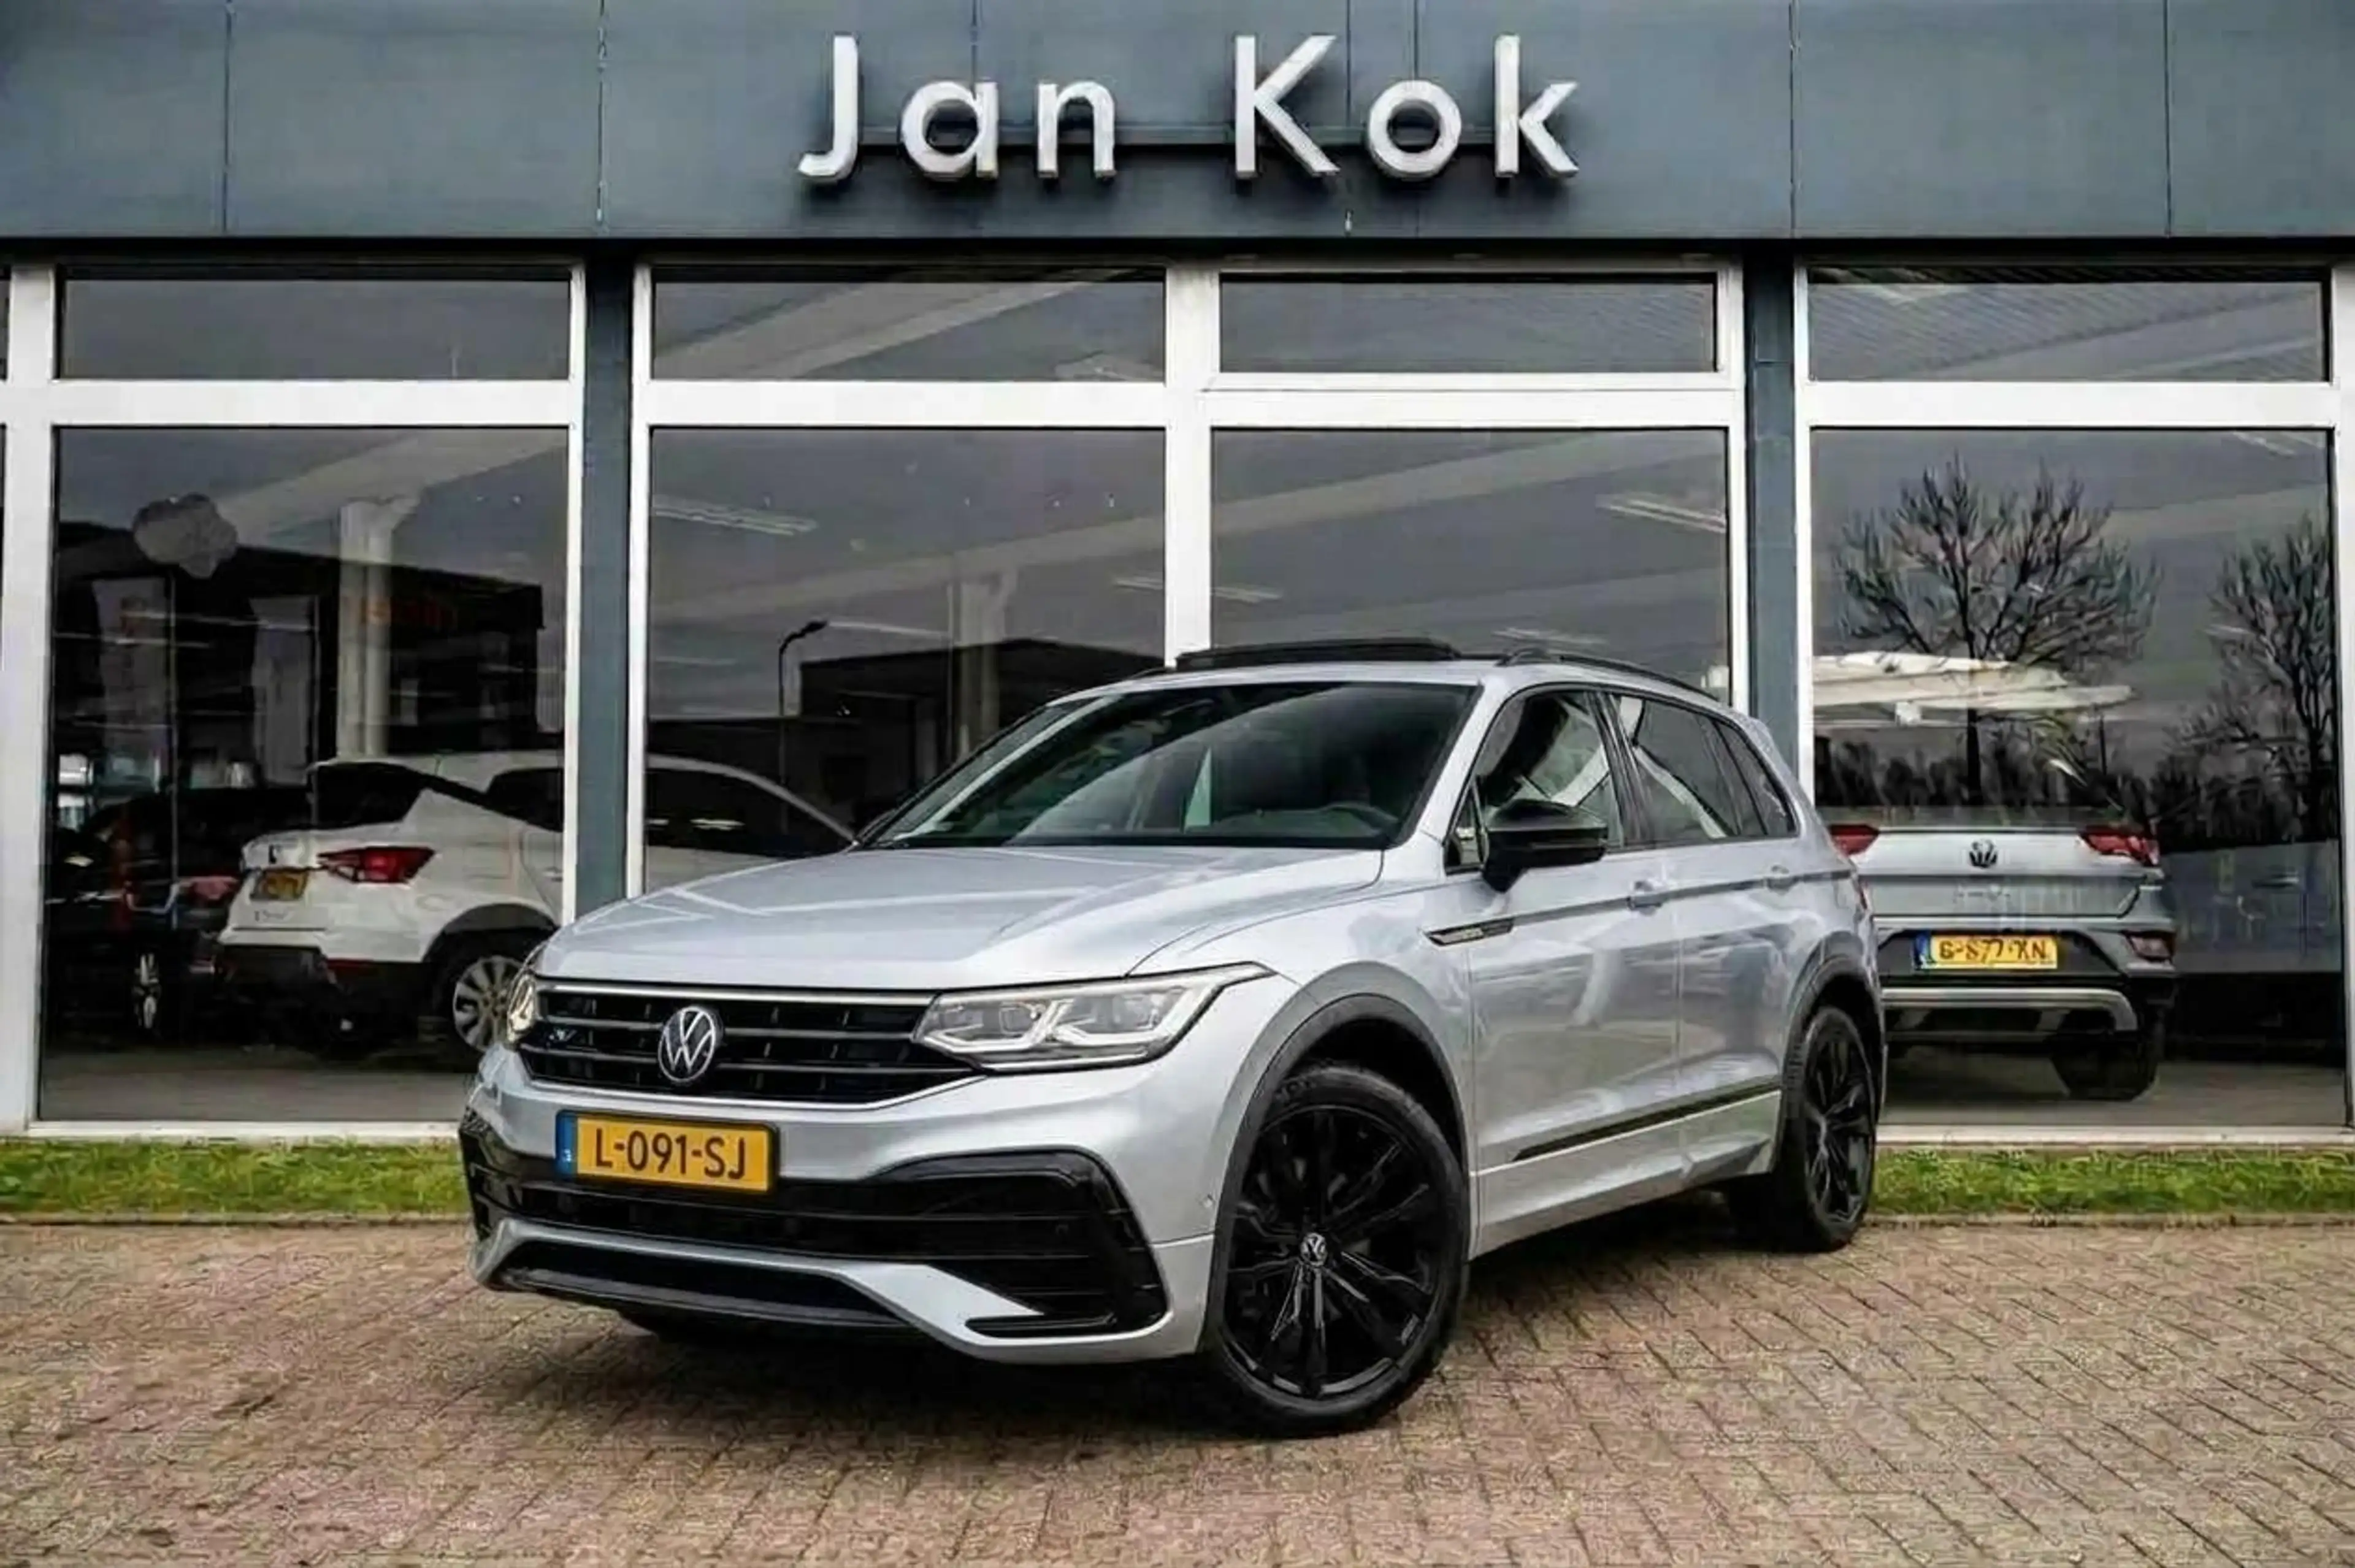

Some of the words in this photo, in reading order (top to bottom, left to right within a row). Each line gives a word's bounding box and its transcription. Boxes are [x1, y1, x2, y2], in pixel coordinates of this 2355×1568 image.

[798, 34, 1116, 180] Jan
[1234, 34, 1579, 179] Kok
[595, 1127, 746, 1179] L-091-SJ
